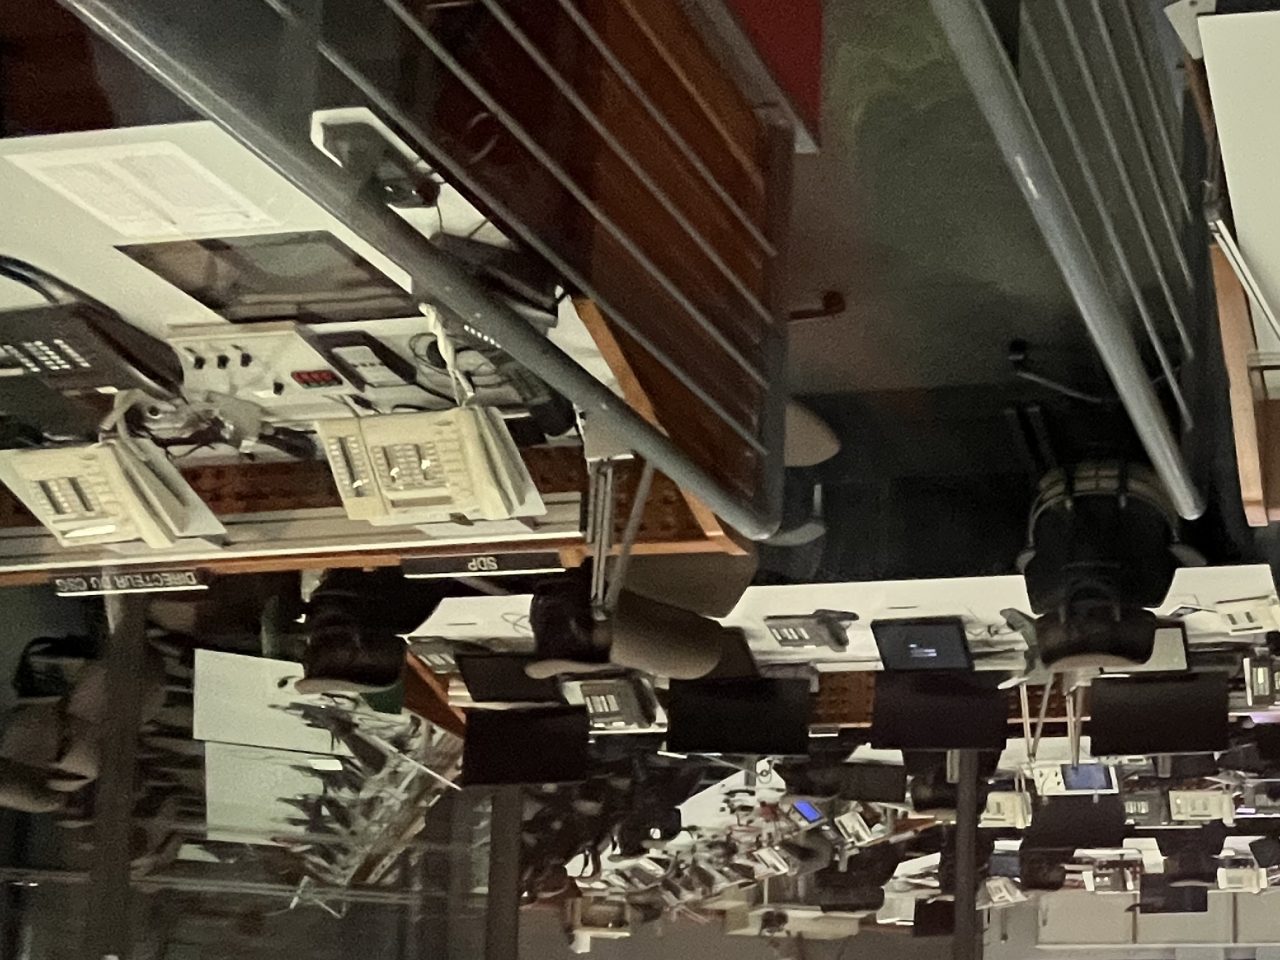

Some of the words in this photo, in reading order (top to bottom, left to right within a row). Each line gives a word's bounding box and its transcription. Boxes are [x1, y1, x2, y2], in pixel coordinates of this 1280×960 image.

[467, 556, 498, 571] SDP
[55, 577, 88, 593] CSG
[113, 571, 197, 589] DIRECTEUR
